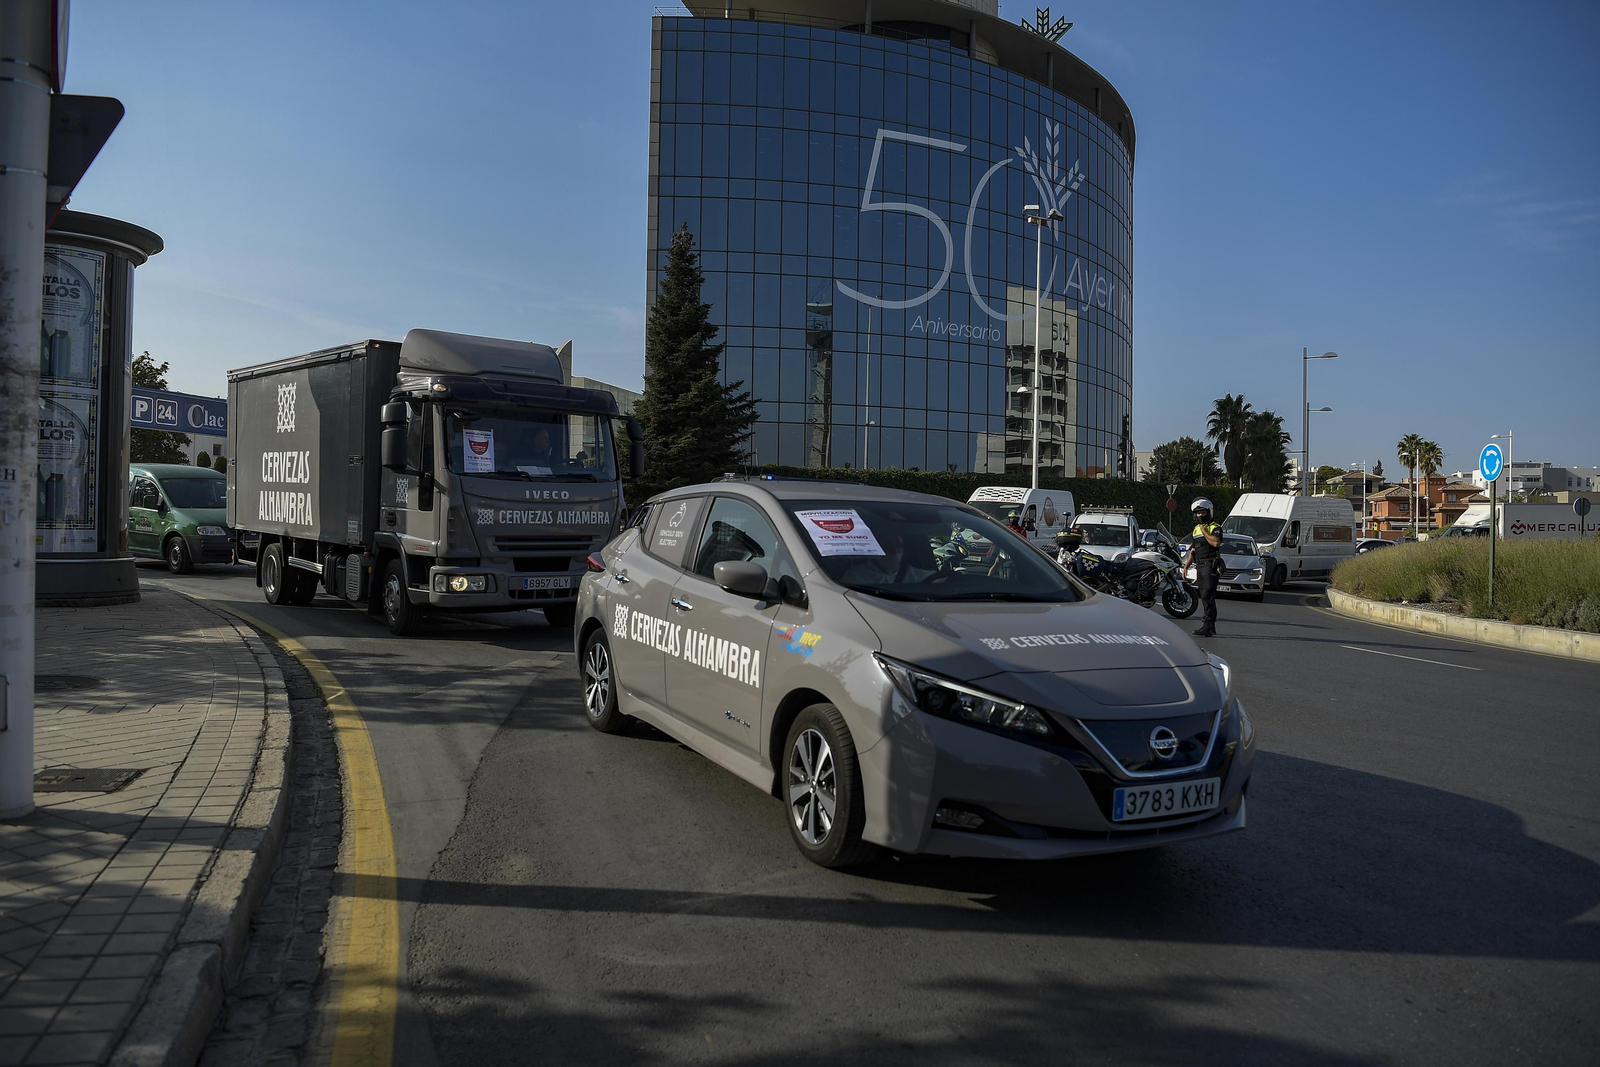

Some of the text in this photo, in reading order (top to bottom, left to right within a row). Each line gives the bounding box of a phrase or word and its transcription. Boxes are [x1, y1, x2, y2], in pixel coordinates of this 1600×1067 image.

[43, 276, 80, 287] TALLA
[910, 315, 1001, 343] Aniversario
[135, 400, 149, 418] P
[38, 420, 75, 428] TALLA
[38, 429, 75, 441] LOS
[262, 450, 310, 484] CERVEZAS
[525, 490, 570, 500] IVECO
[258, 490, 313, 526] ALHAMBRA
[499, 510, 610, 525] CERVEZAS ALHAMBRA
[529, 578, 569, 588] 6957 GLY
[1010, 633, 1169, 648] CERVEZAS ALHAMBRA
[631, 611, 760, 688] CERVEZAS ALHAMBRA
[1126, 782, 1215, 815] 3783 KXH
